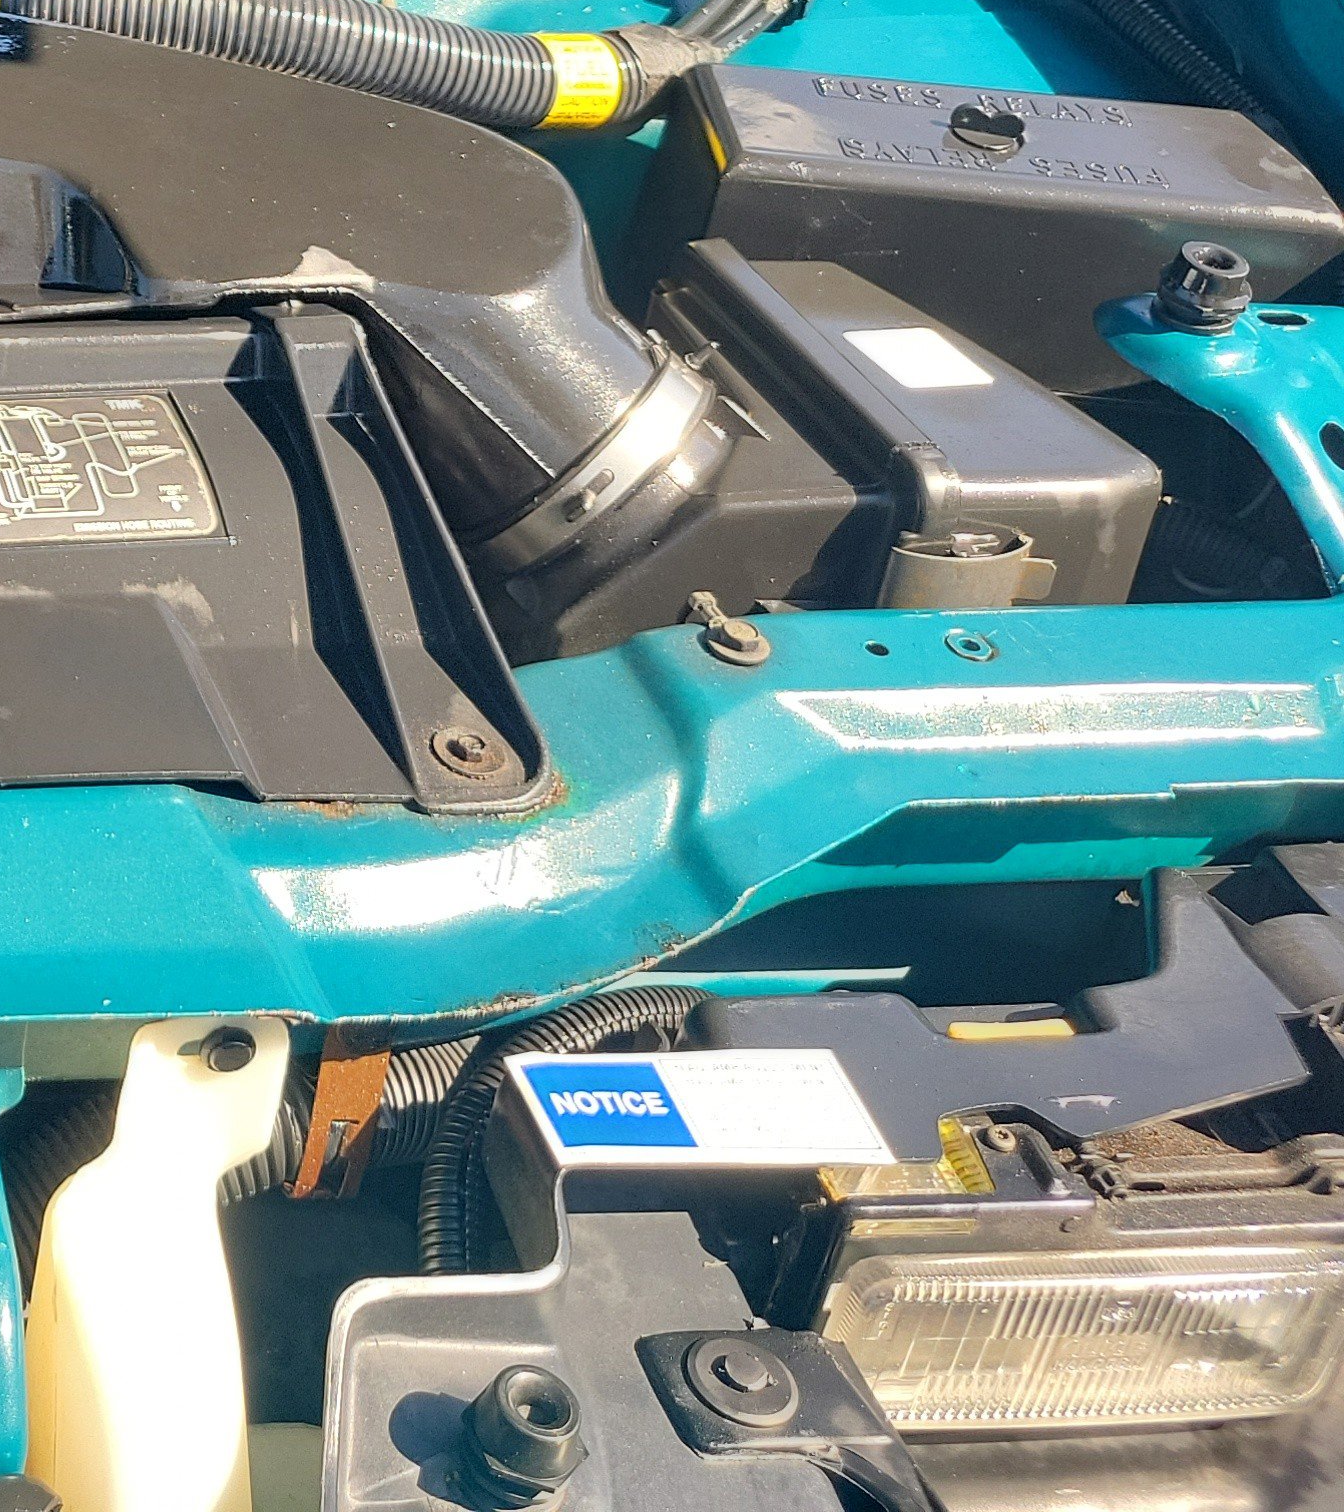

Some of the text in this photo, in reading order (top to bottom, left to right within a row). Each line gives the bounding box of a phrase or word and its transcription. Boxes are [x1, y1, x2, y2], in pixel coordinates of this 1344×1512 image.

[815, 78, 1125, 126] FUSES RELAYS
[845, 139, 1168, 190] RELAYS FUSES
[550, 1091, 670, 1115] NOTICE
